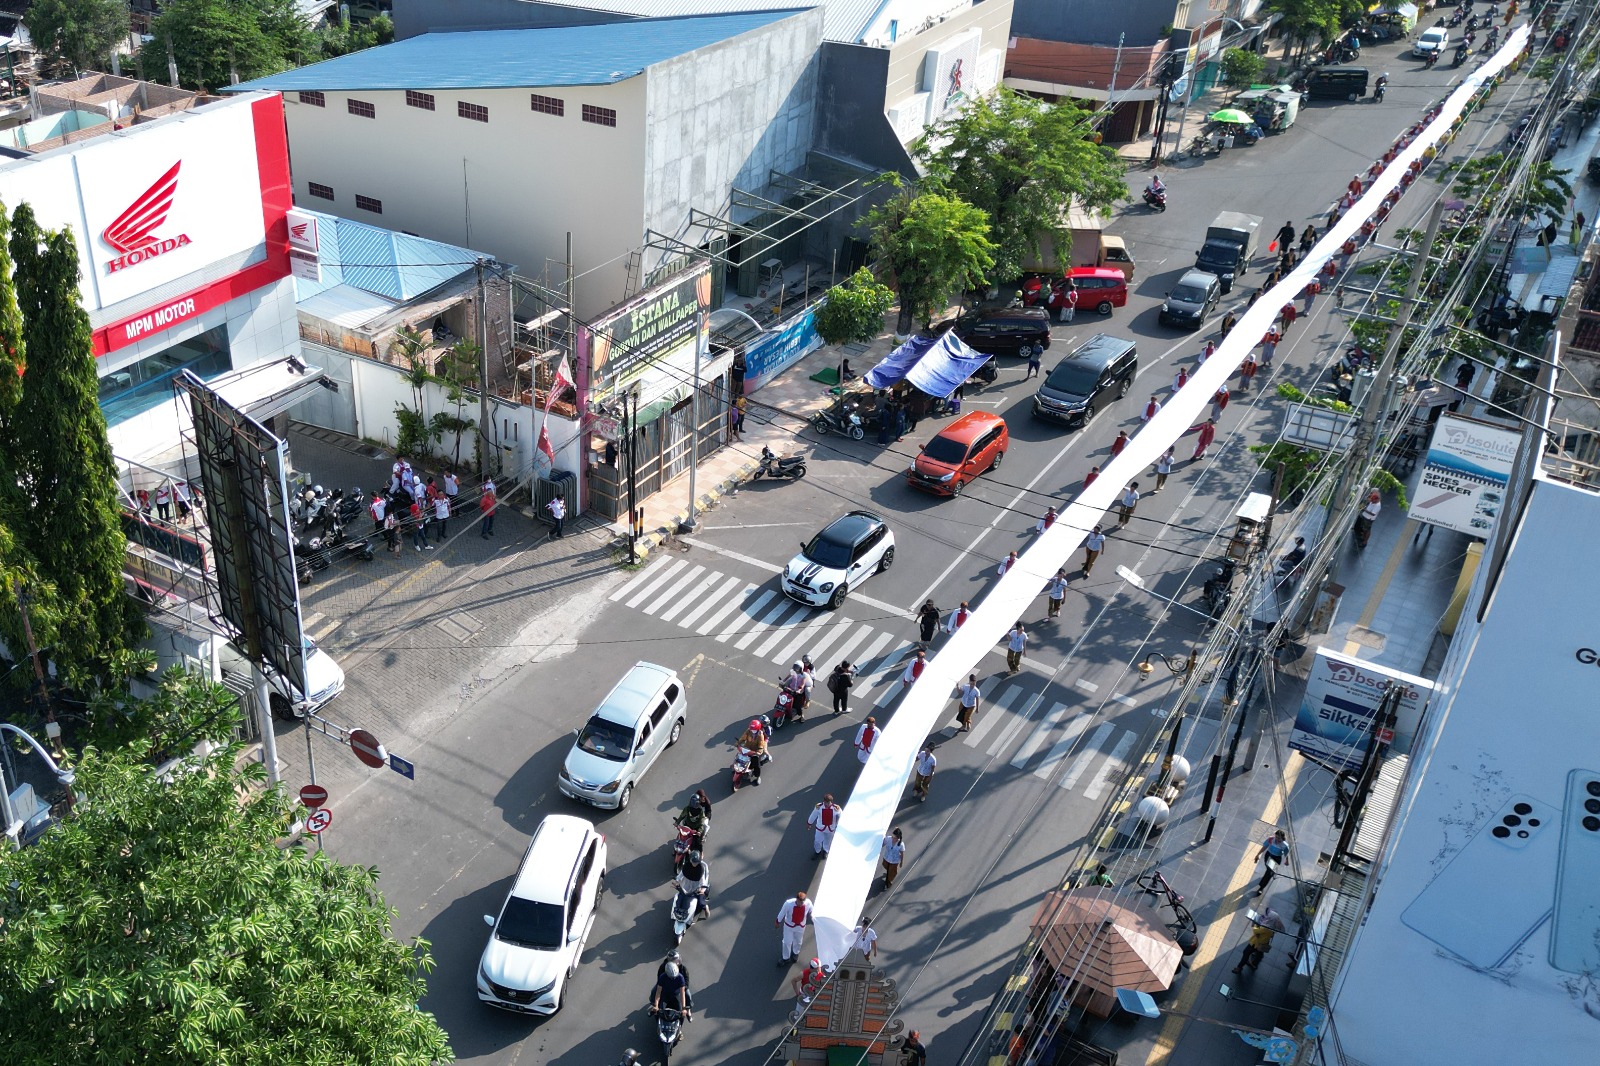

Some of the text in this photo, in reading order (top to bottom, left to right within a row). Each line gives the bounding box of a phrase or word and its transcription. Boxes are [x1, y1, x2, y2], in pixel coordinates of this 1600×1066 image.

[108, 233, 193, 274] HONDA
[125, 298, 196, 339] MPM MOTOR
[631, 291, 680, 333] ISTANA
[641, 325, 657, 342] DAN
[658, 300, 698, 332] WALLPAPER
[1423, 478, 1472, 496] HECKER
[1425, 472, 1460, 486] SPIES
[1326, 660, 1420, 701] Absote
